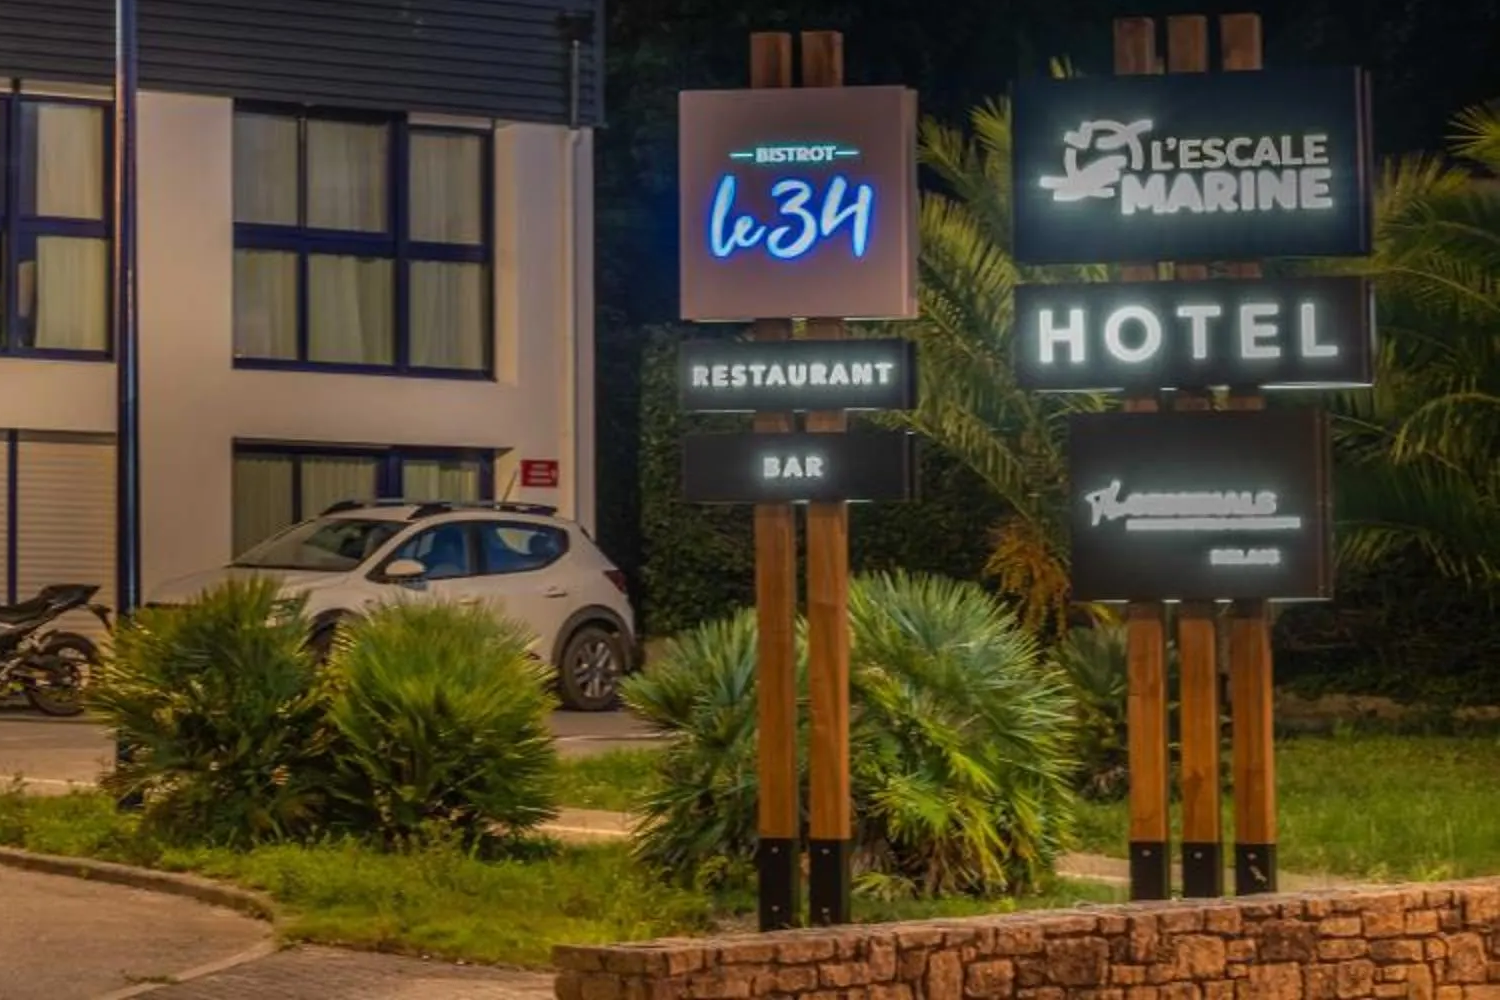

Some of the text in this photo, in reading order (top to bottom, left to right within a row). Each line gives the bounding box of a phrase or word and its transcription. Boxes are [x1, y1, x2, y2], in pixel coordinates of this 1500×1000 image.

[755, 146, 836, 164] BISTROT
[1151, 135, 1329, 171] L'ESCALE
[1120, 168, 1333, 215] MARINE
[1038, 303, 1339, 364] HOTEL
[692, 362, 894, 387] RESTAURANT
[762, 456, 825, 479] BAR
